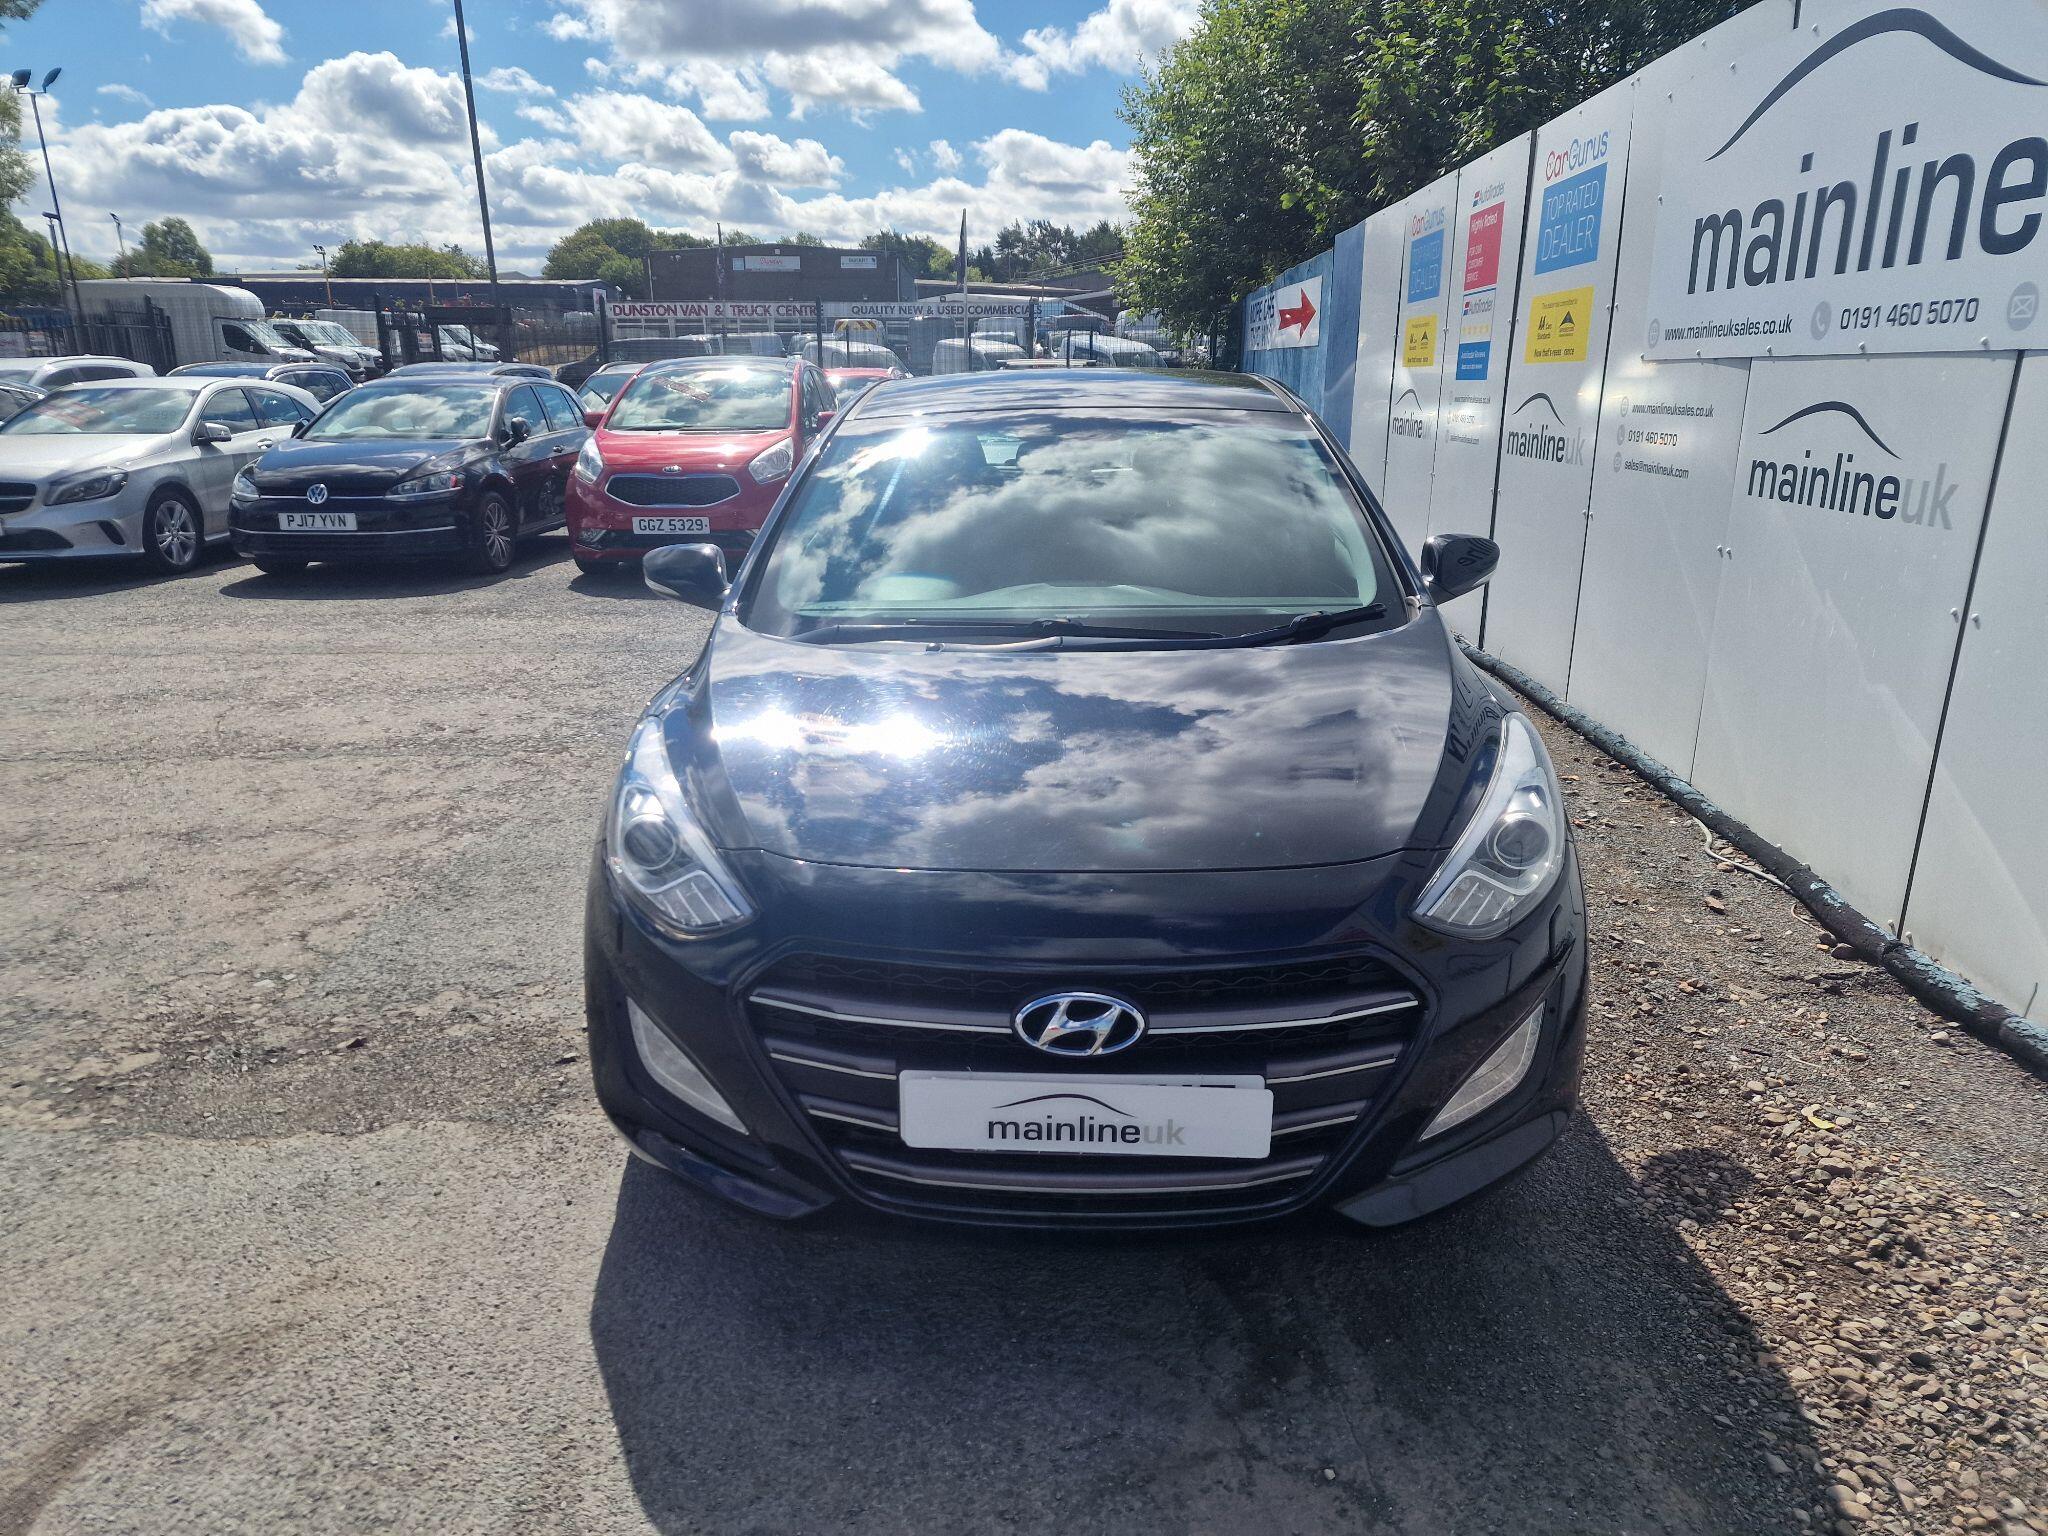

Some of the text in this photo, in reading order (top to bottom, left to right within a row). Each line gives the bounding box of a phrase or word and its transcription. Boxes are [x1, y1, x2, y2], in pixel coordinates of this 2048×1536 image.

[1546, 131, 1608, 181] CarGurus
[1547, 180, 1600, 222] TOP RATED
[1688, 122, 2048, 294] mainline
[1412, 206, 1445, 236] CarGurus
[1541, 215, 1595, 261] DEALER
[612, 304, 678, 317] DUNSTON
[680, 304, 709, 316] VAN
[714, 305, 724, 316] &
[729, 304, 772, 317] TRUCK
[851, 304, 1043, 316] QUALITY NEW & USED COMMERCIAS
[1665, 297, 1980, 341] www.mainlineuksales.co.uk 0191 460 5070
[1632, 402, 1714, 418] www.mainlineuksales.co.uk
[1507, 423, 1586, 466] mainlineuk
[1628, 429, 1678, 447] 0191 460 5070
[1748, 450, 1959, 530] mainlineuk
[287, 515, 347, 527] PJ17 YVN
[639, 518, 704, 532] GGZ 5329
[988, 1115, 1187, 1146] mainlineuk
